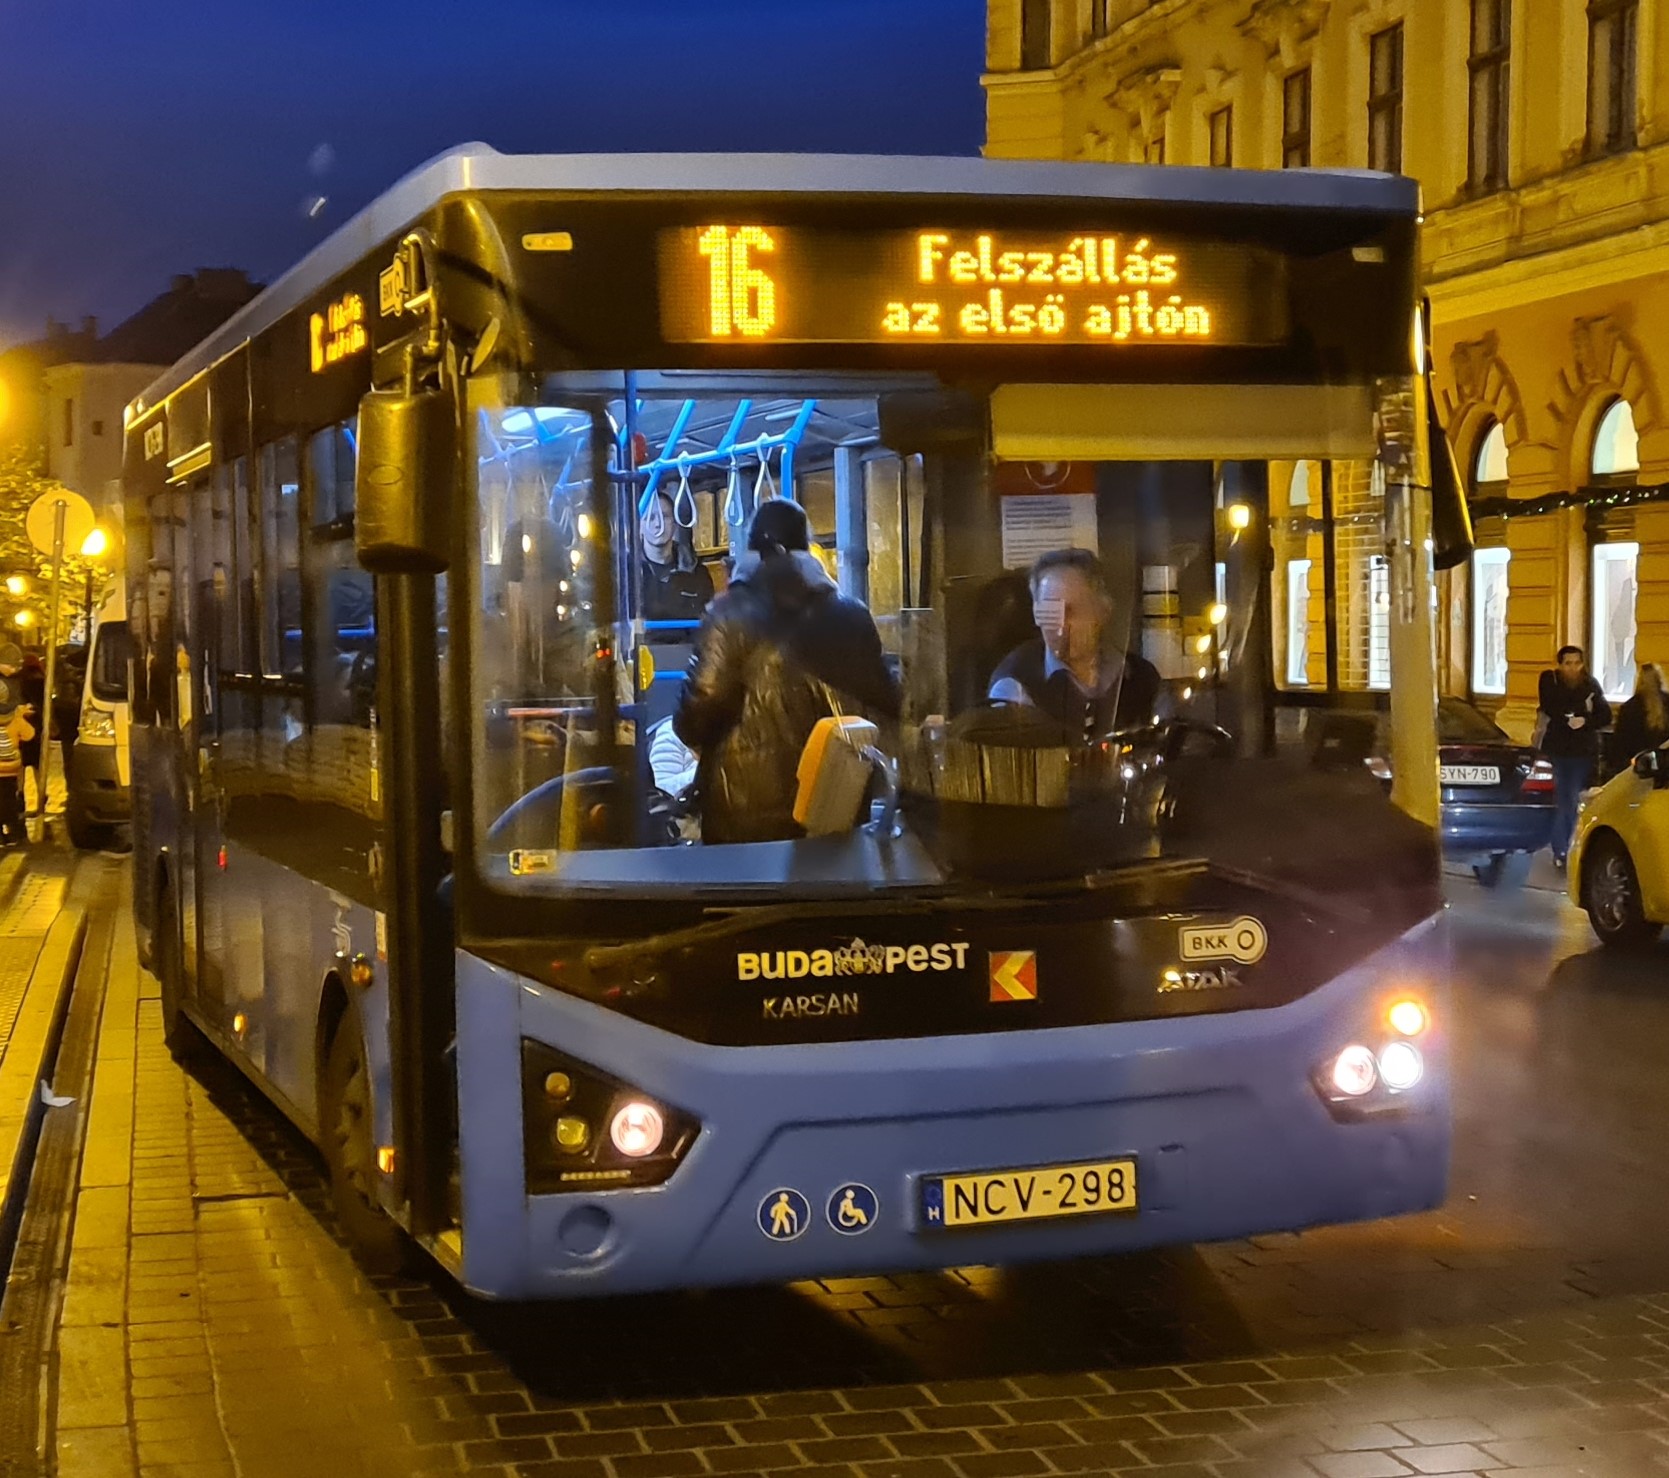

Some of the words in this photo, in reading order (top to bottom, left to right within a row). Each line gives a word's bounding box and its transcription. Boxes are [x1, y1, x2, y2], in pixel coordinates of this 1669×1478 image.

[699, 225, 776, 336] 16
[917, 233, 1178, 284] Felszállás
[882, 301, 941, 334] az
[1083, 289, 1211, 340] ajtón
[1192, 935, 1229, 951] BKK
[763, 992, 859, 1018] KARSAN
[927, 1206, 941, 1221] H
[954, 1168, 1125, 1219] NCV-298
